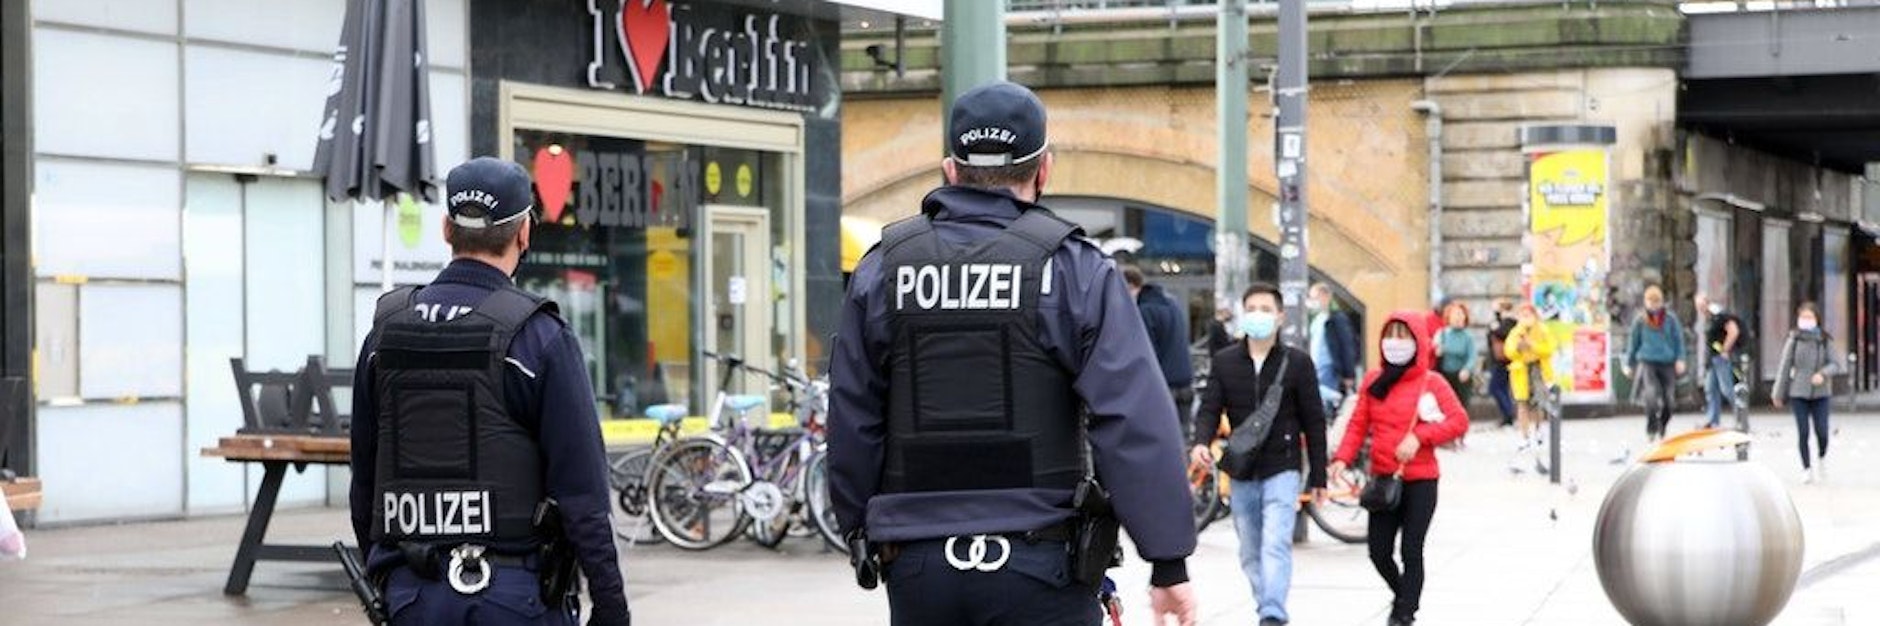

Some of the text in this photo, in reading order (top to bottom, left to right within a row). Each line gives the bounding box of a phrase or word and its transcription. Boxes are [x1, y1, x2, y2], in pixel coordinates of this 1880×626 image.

[662, 1, 816, 111] Berlin
[959, 127, 1017, 146] POLIZEI
[449, 189, 499, 211] POLIZEI
[896, 263, 1022, 310] POLIZEI
[383, 490, 491, 535] POLIZEI
